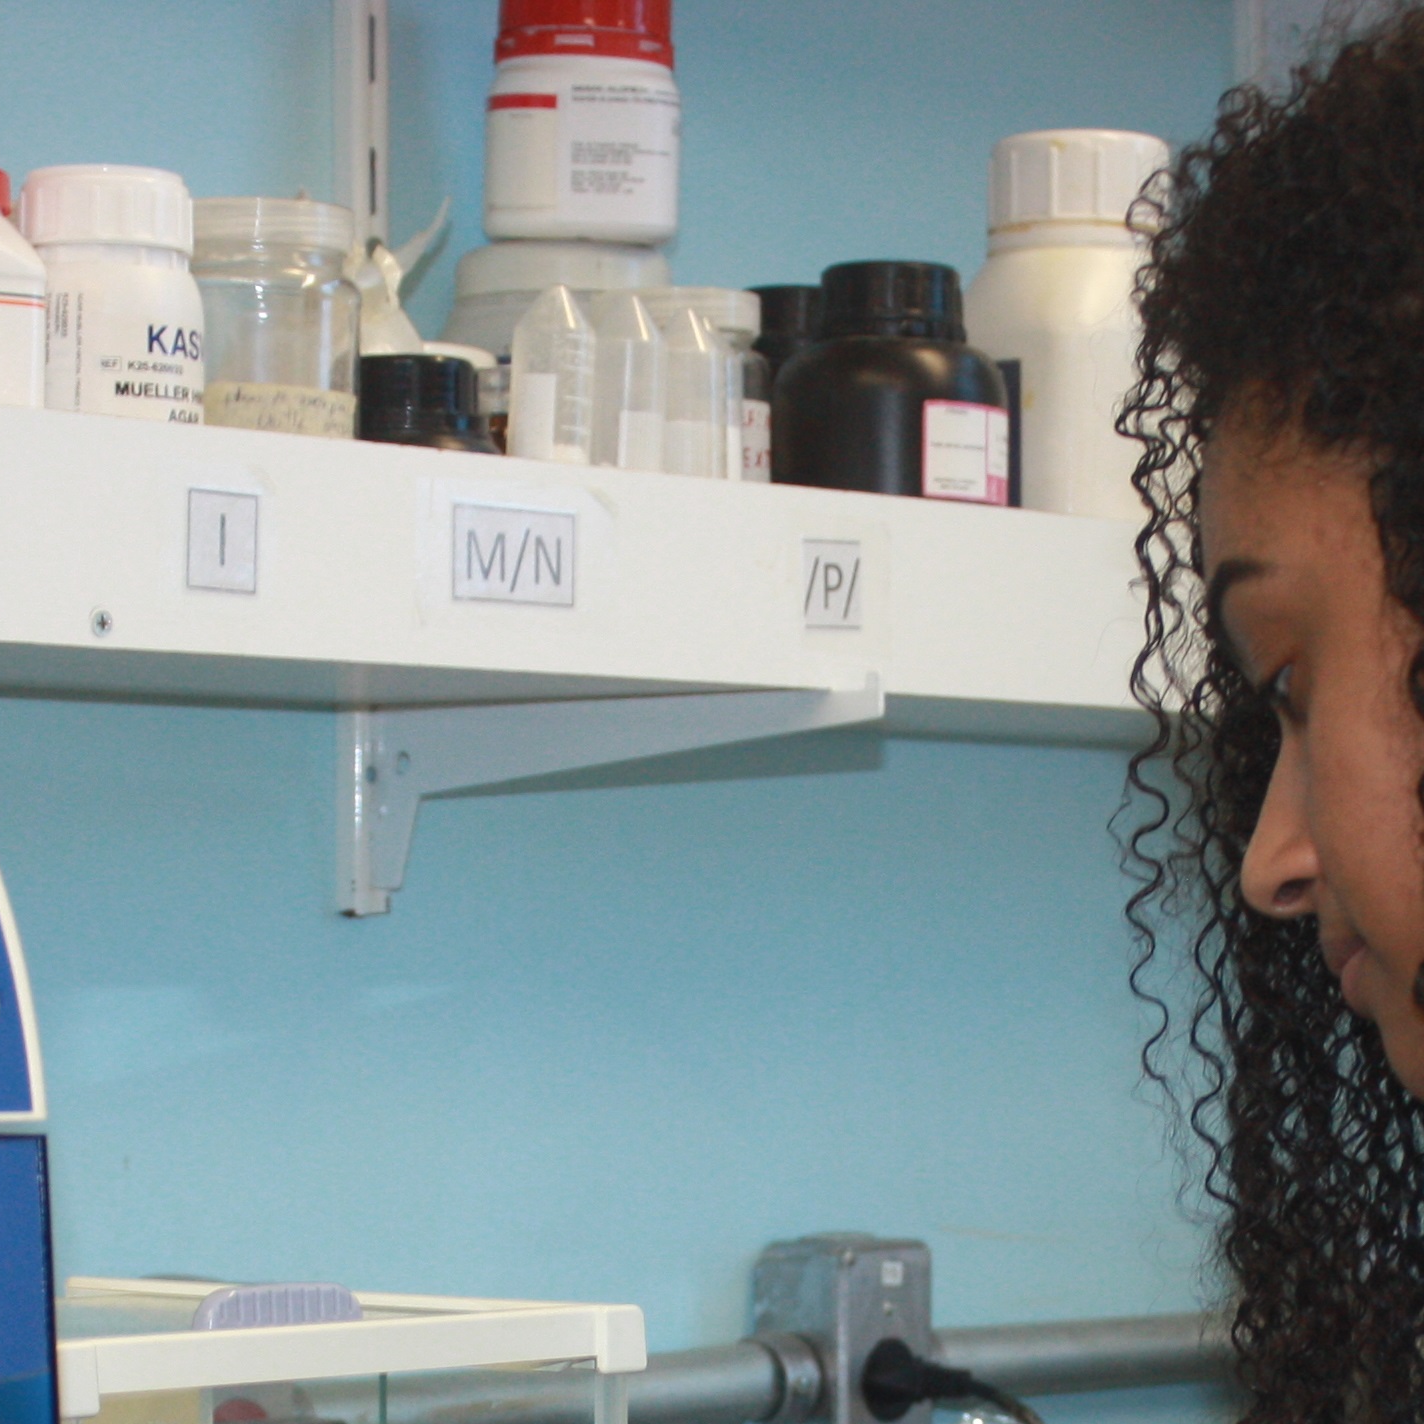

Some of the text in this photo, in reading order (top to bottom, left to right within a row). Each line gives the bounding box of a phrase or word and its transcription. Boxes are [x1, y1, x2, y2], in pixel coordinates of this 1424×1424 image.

[147, 323, 204, 362] KAS
[115, 381, 189, 403] MUELLER
[466, 528, 563, 594] M/N
